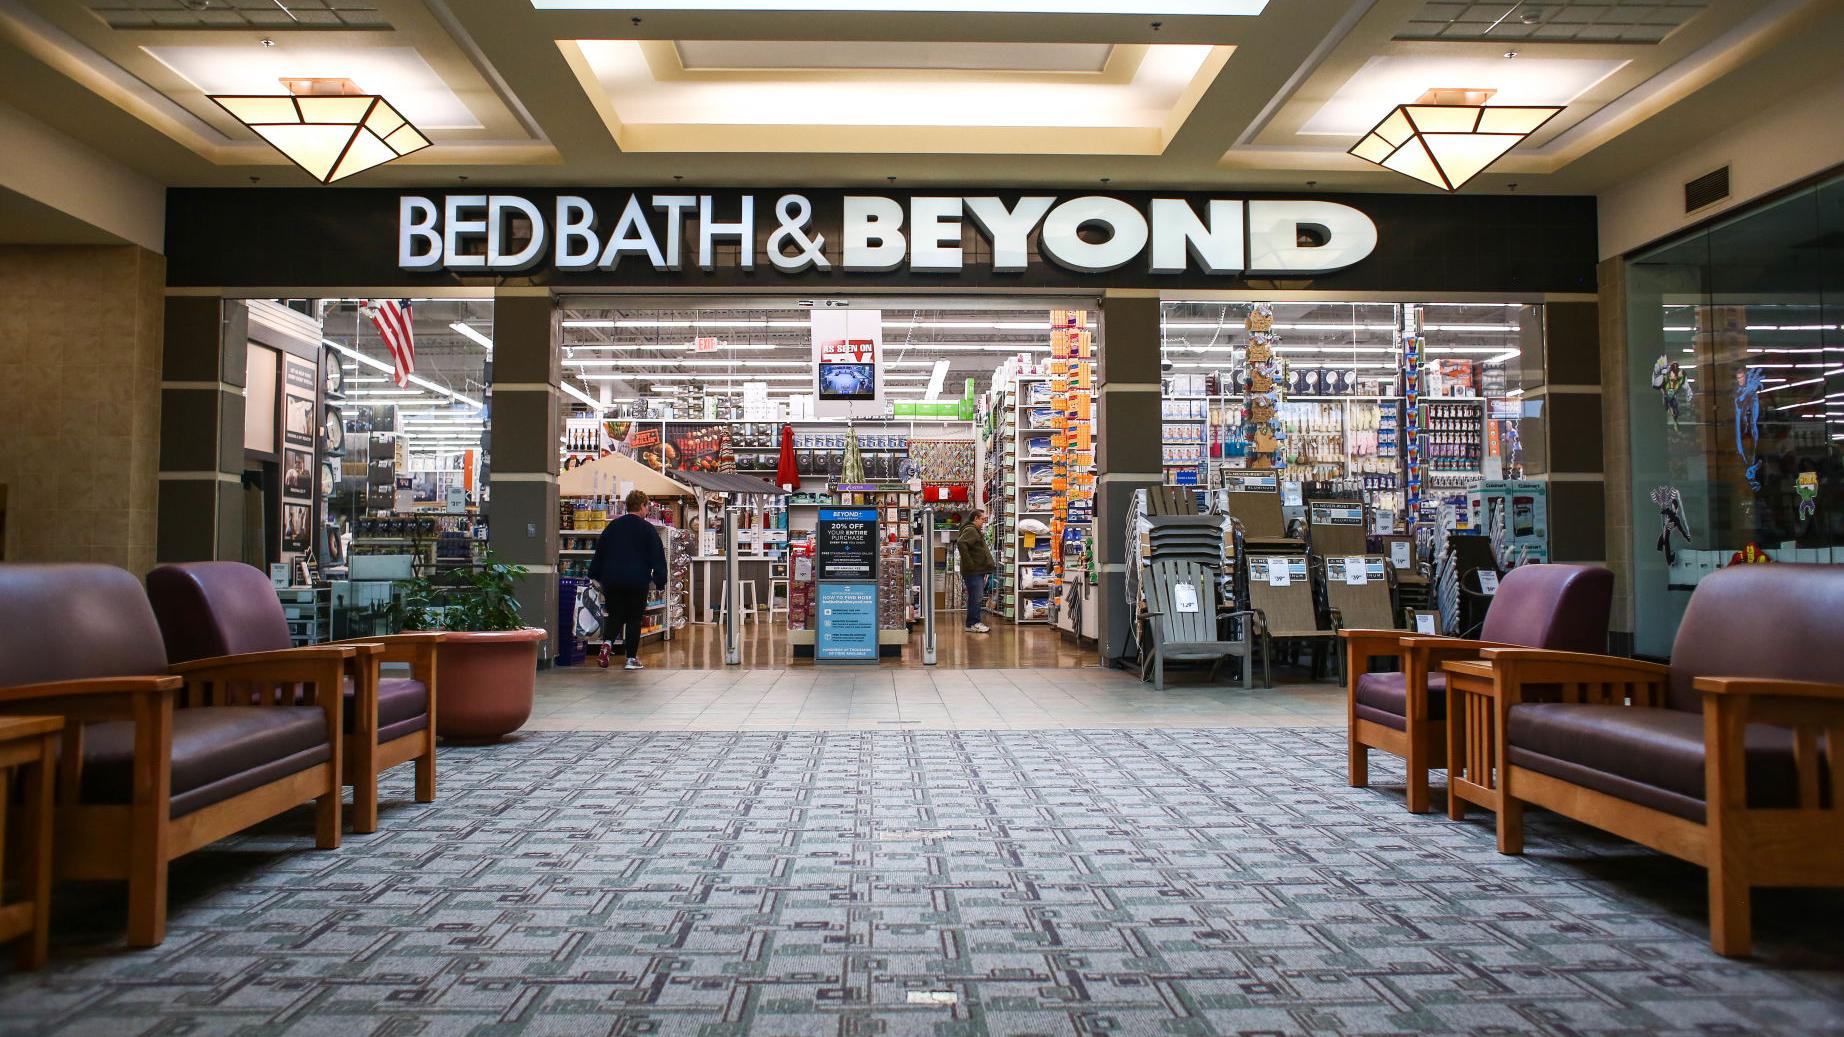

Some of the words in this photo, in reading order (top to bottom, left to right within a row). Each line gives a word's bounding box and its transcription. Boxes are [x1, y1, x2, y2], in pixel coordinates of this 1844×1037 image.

[399, 195, 546, 270] BED
[555, 193, 755, 270] BATH
[766, 194, 831, 271] &
[842, 195, 1379, 273] BEYOND
[698, 338, 714, 351] EXIT
[837, 344, 858, 352] SEEN
[860, 344, 873, 352] ON
